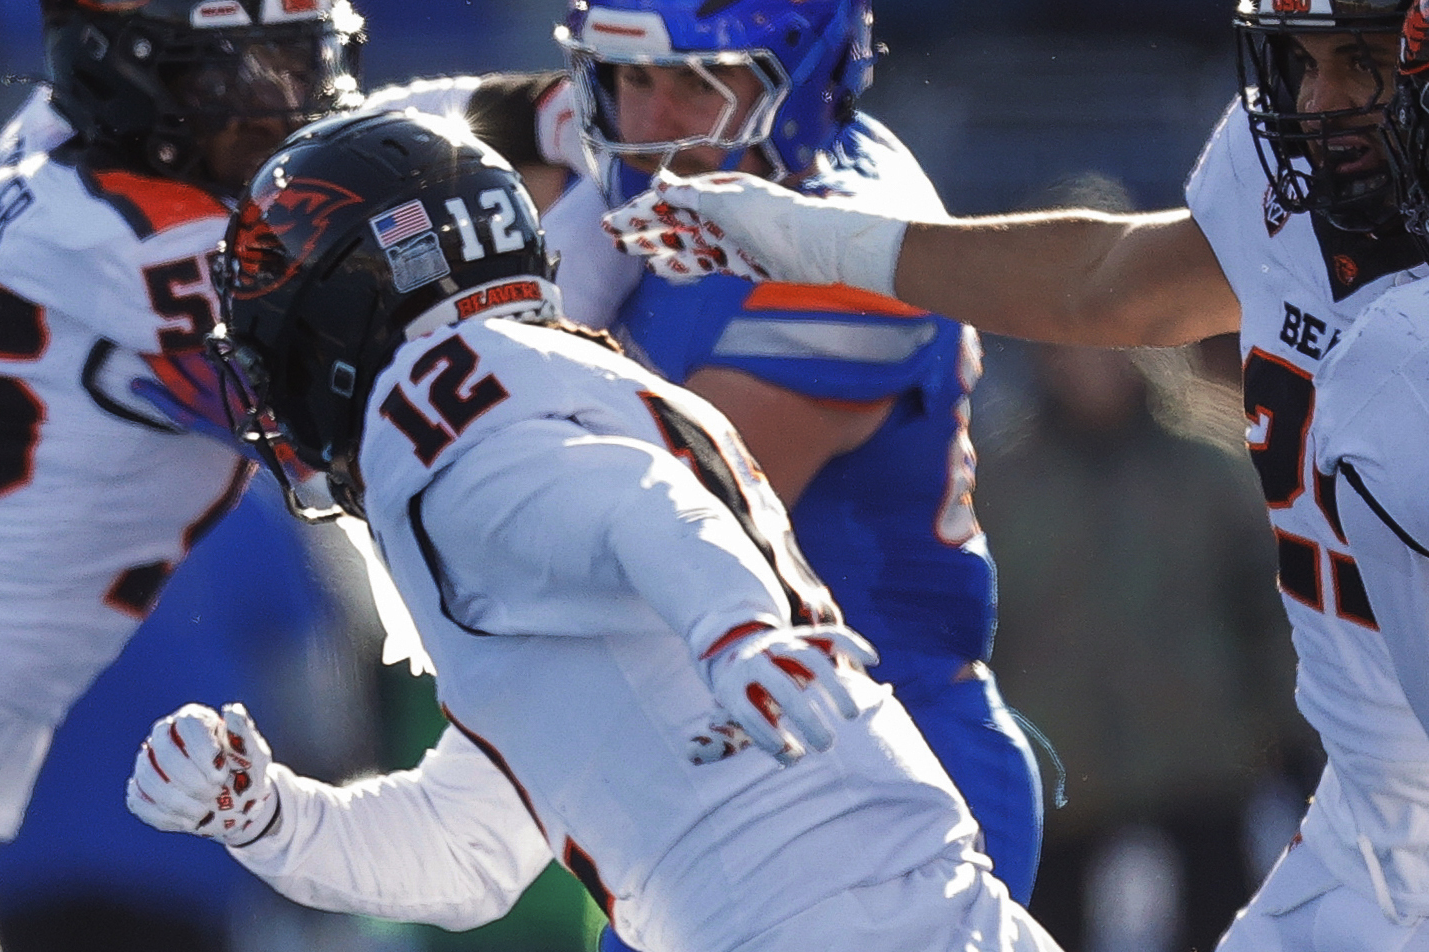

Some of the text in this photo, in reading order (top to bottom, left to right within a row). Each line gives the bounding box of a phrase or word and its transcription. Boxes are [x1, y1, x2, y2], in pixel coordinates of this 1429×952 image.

[445, 188, 525, 262] 12
[140, 250, 223, 352] 5
[379, 333, 511, 468] 12
